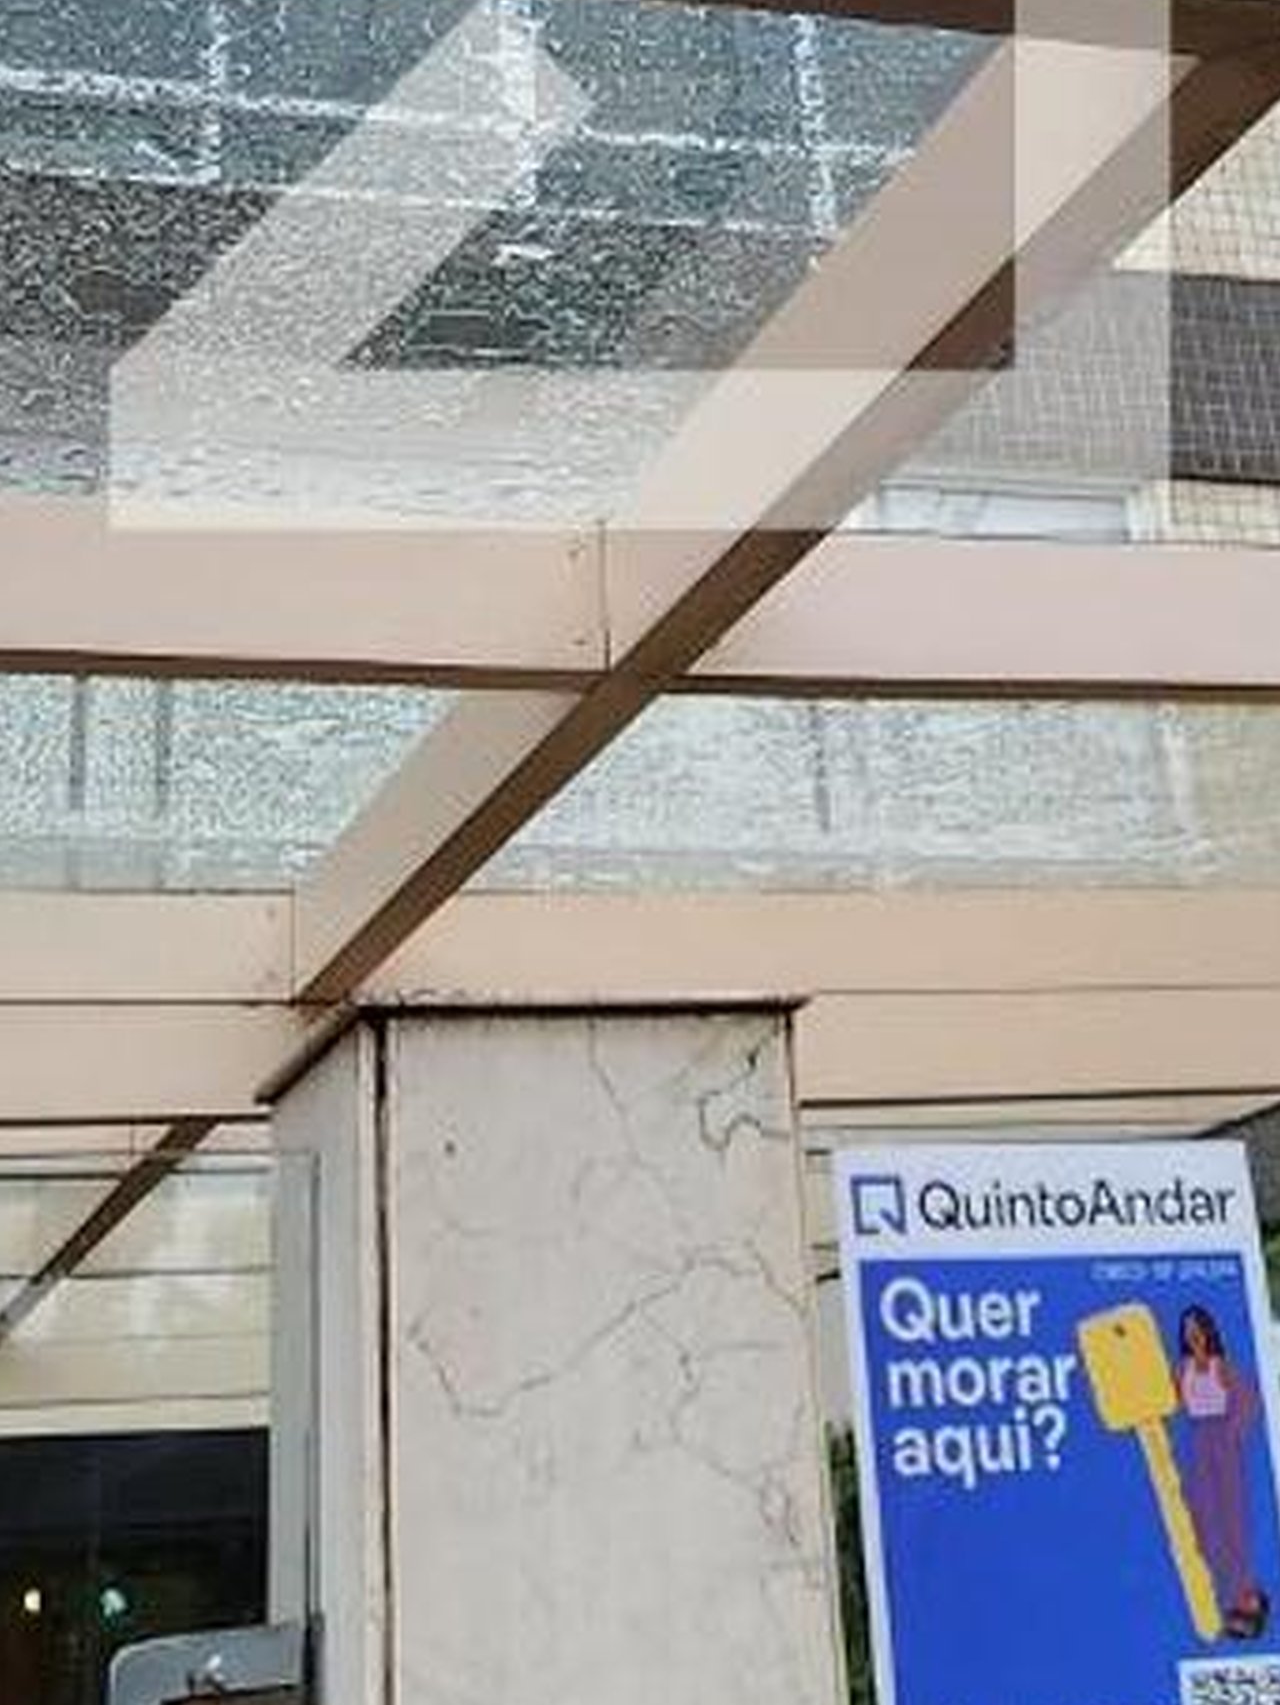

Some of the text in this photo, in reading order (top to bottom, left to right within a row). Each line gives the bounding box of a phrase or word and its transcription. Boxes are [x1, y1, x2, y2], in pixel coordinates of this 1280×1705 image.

[919, 1176, 1236, 1231] QuintoAndar
[880, 1276, 1040, 1343] Quer
[887, 1353, 1076, 1409] morar
[892, 1405, 1067, 1490] aqui?
